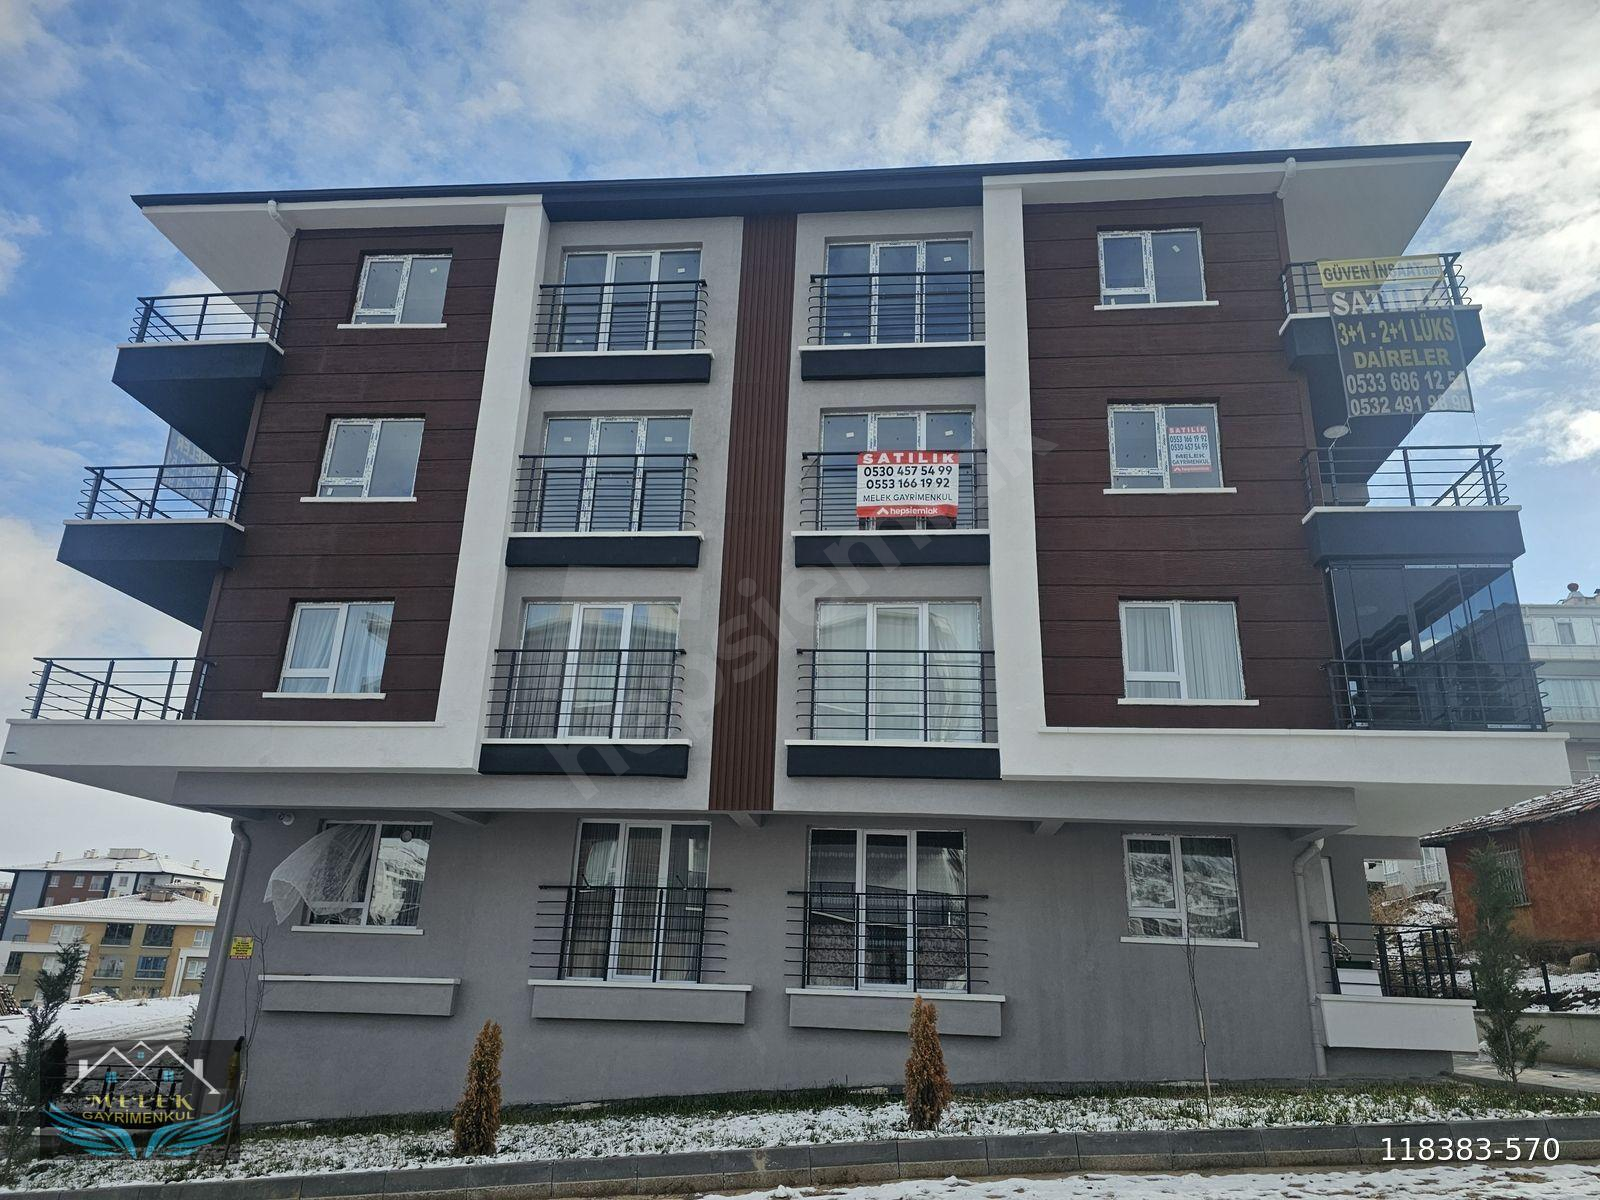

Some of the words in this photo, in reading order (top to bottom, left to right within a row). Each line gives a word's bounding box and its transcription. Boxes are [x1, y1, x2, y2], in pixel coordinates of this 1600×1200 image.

[1323, 263, 1370, 282] GÜVEN
[1338, 321, 1366, 346] 3+1
[1379, 319, 1408, 343] 2+1
[1411, 313, 1455, 342] LÜKS
[1353, 346, 1451, 369] DAİRELER
[1346, 372, 1386, 394] 0533
[1390, 371, 1420, 392] 686
[1424, 370, 1445, 389] 12
[1350, 396, 1391, 416] 0532
[1395, 395, 1422, 413] 491
[862, 452, 955, 464] SATILIK
[863, 466, 894, 477] 0530
[897, 466, 918, 476] 457
[921, 466, 935, 475] 54
[938, 465, 953, 475] 99
[866, 479, 895, 489] 0553
[898, 478, 918, 488] 166
[920, 478, 932, 488] 19
[935, 477, 950, 488] 92
[863, 494, 891, 502] MELEK
[893, 492, 952, 501] GAYRİMENKUL
[890, 506, 938, 516] hepsiemlak
